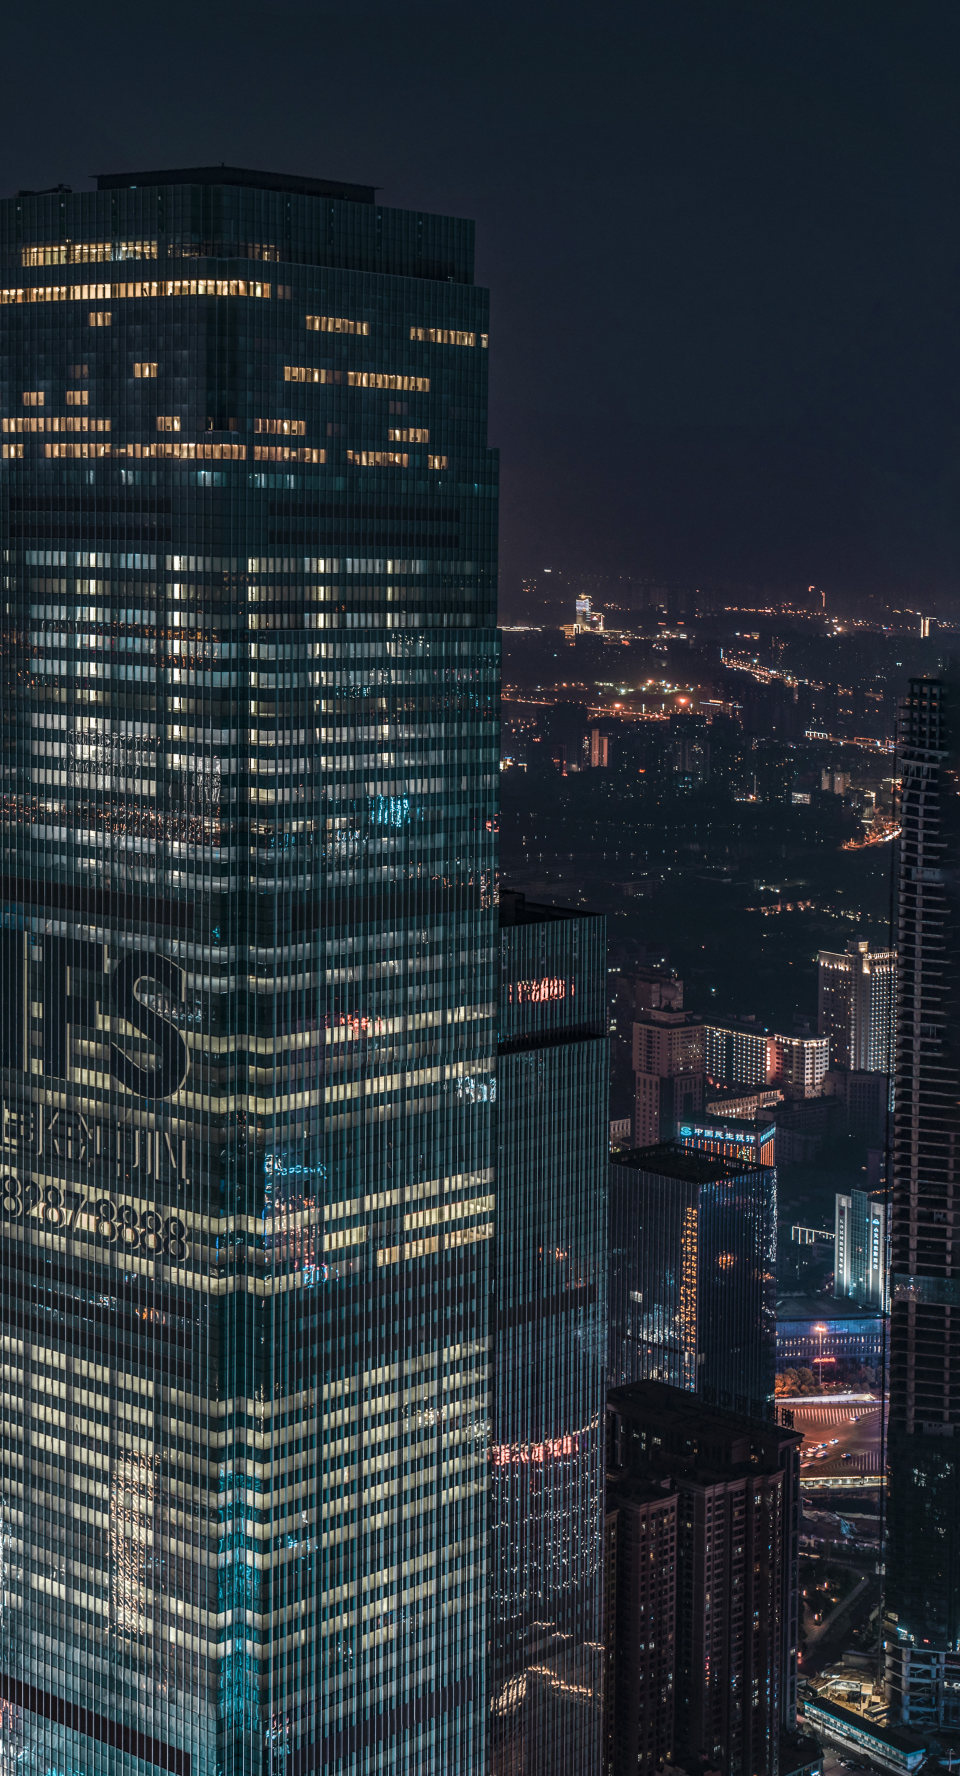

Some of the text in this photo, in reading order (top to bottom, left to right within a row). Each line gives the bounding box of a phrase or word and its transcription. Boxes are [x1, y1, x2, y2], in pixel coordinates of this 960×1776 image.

[0, 927, 190, 1100] IFS
[694, 1128, 756, 1144] 中国民生银行
[0, 1174, 191, 1263] 8287 8888
